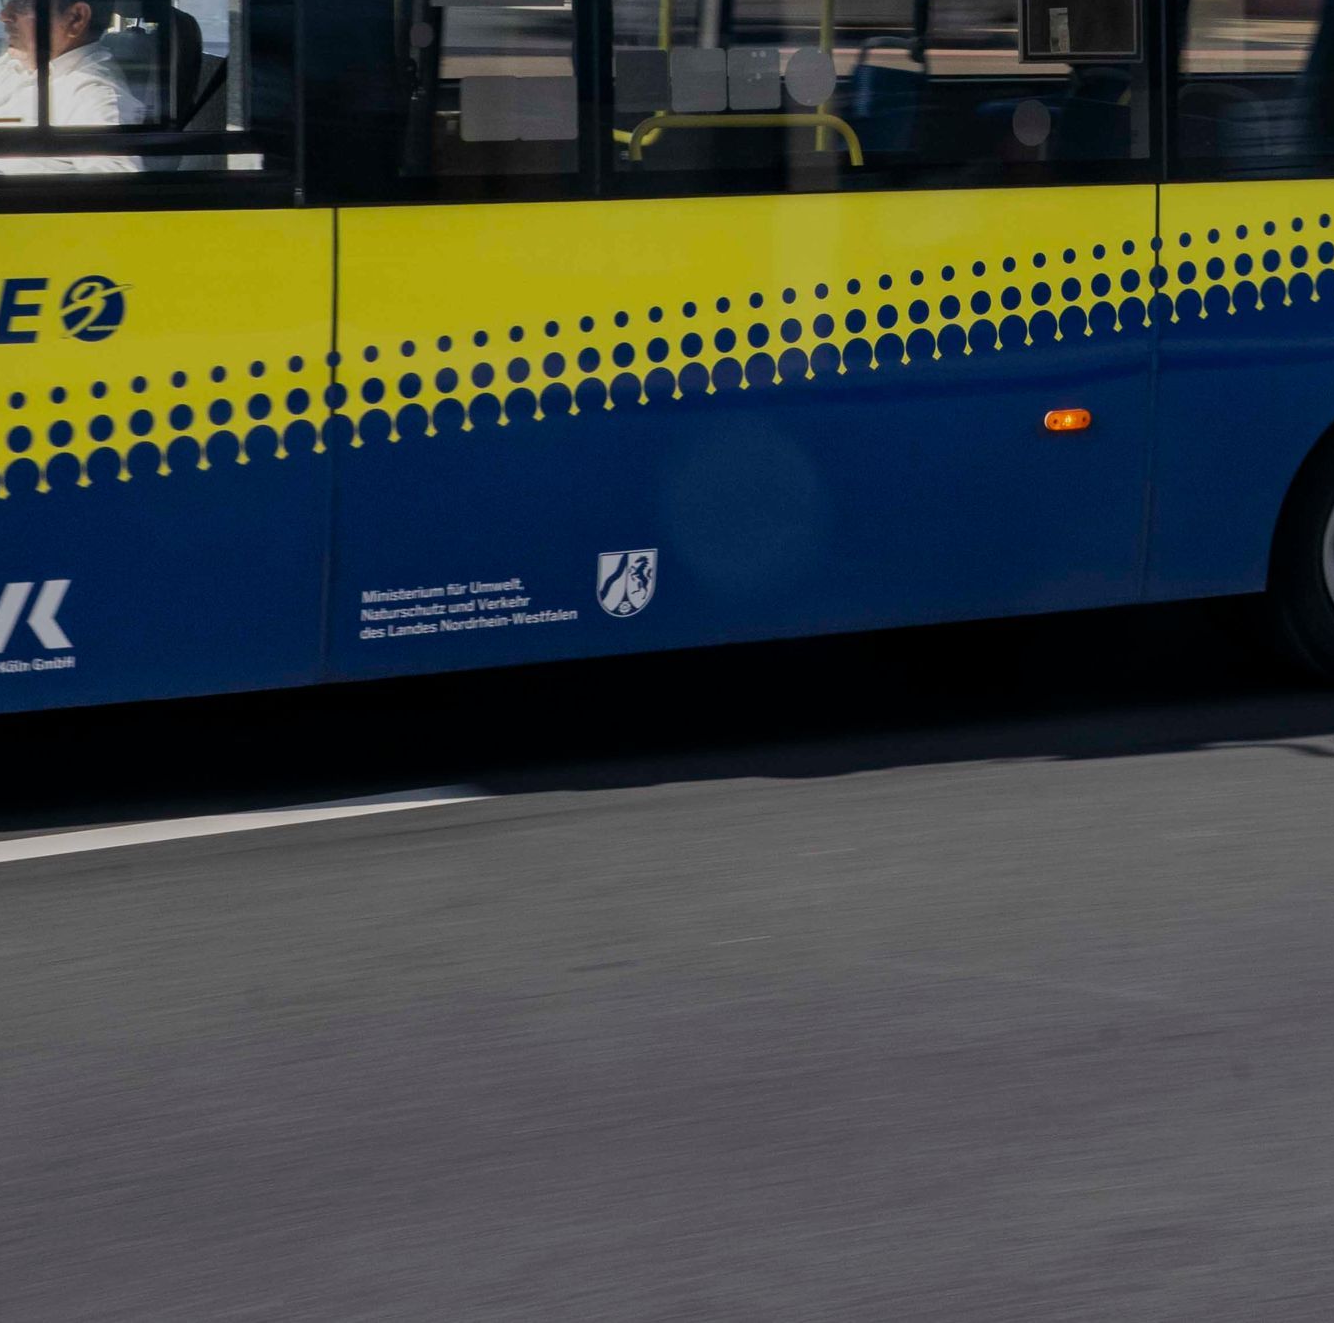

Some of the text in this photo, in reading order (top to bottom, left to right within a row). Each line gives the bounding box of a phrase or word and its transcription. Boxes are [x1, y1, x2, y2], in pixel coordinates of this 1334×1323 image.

[361, 578, 525, 603] Ministerium für Umwelt,
[360, 595, 531, 621] Naturschutz und Verkehr
[359, 608, 579, 639] des Landes Nordrhein-Westfalen
[32, 656, 76, 671] GmbH
